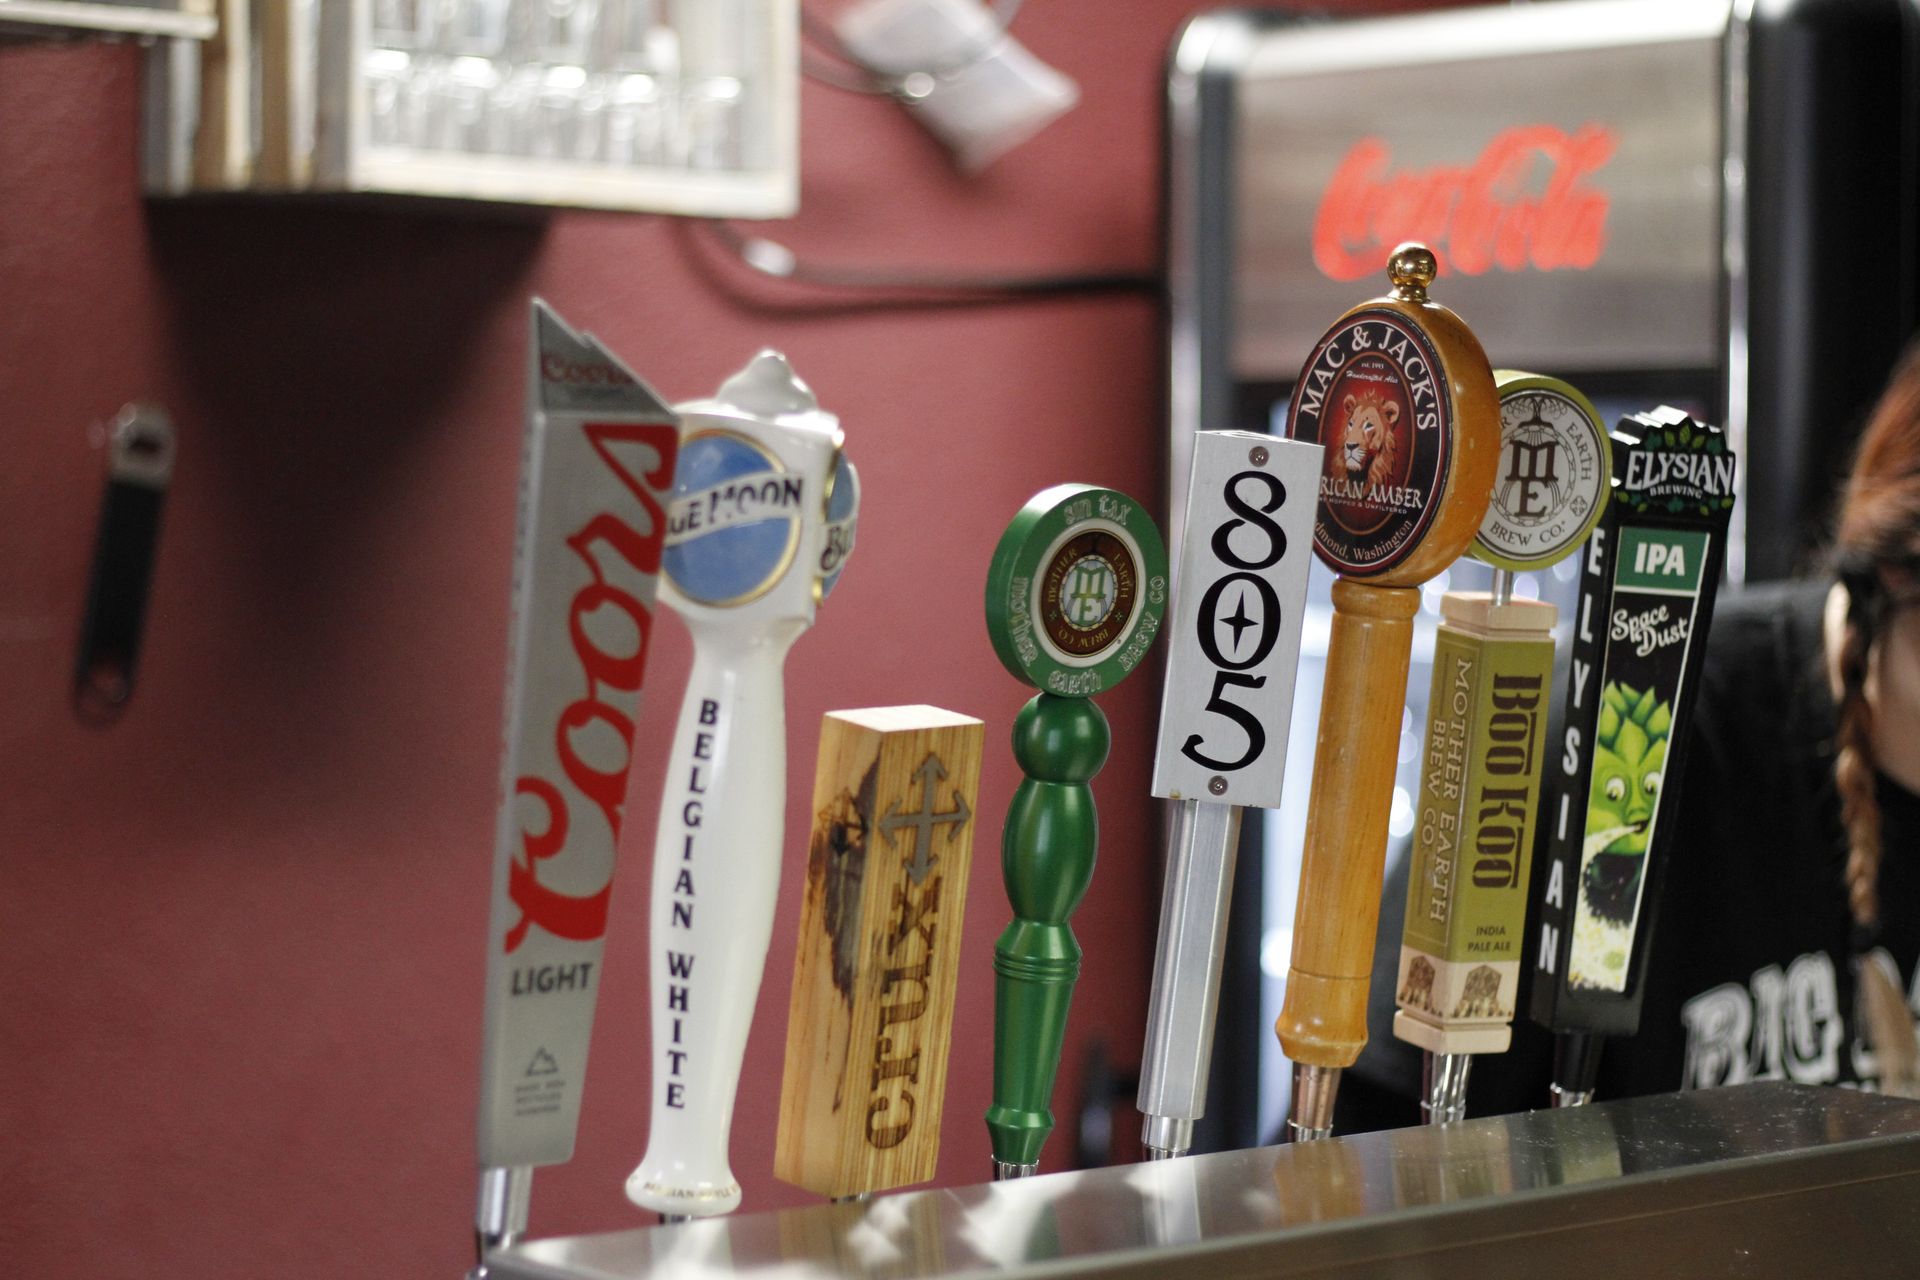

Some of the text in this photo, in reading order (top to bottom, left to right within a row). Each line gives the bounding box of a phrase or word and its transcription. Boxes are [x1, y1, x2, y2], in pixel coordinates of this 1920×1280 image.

[1300, 325, 1438, 431] MAC & JACK'S
[1565, 422, 1593, 481] EARTH
[1319, 475, 1423, 509] RICAN AMBER
[1625, 450, 1735, 496] ELYSIAN
[1649, 484, 1703, 499] BREWING
[1315, 519, 1413, 561] dmond, Washington
[1489, 521, 1533, 546] BREW
[1634, 542, 1686, 576] IPA
[1180, 470, 1288, 772] 805
[1611, 604, 1670, 643] Space
[1636, 618, 1689, 657] Dust
[505, 424, 680, 955] Coors
[1427, 719, 1447, 798] BREW
[1538, 527, 1605, 974] ELYSIAN
[1430, 658, 1472, 925] MOTHER EARTH
[666, 698, 720, 1110] BELGIAN WHITE
[1468, 941, 1511, 952] PALE ALE
[1475, 926, 1506, 936] INDIA
[511, 961, 594, 996] LIGHT
